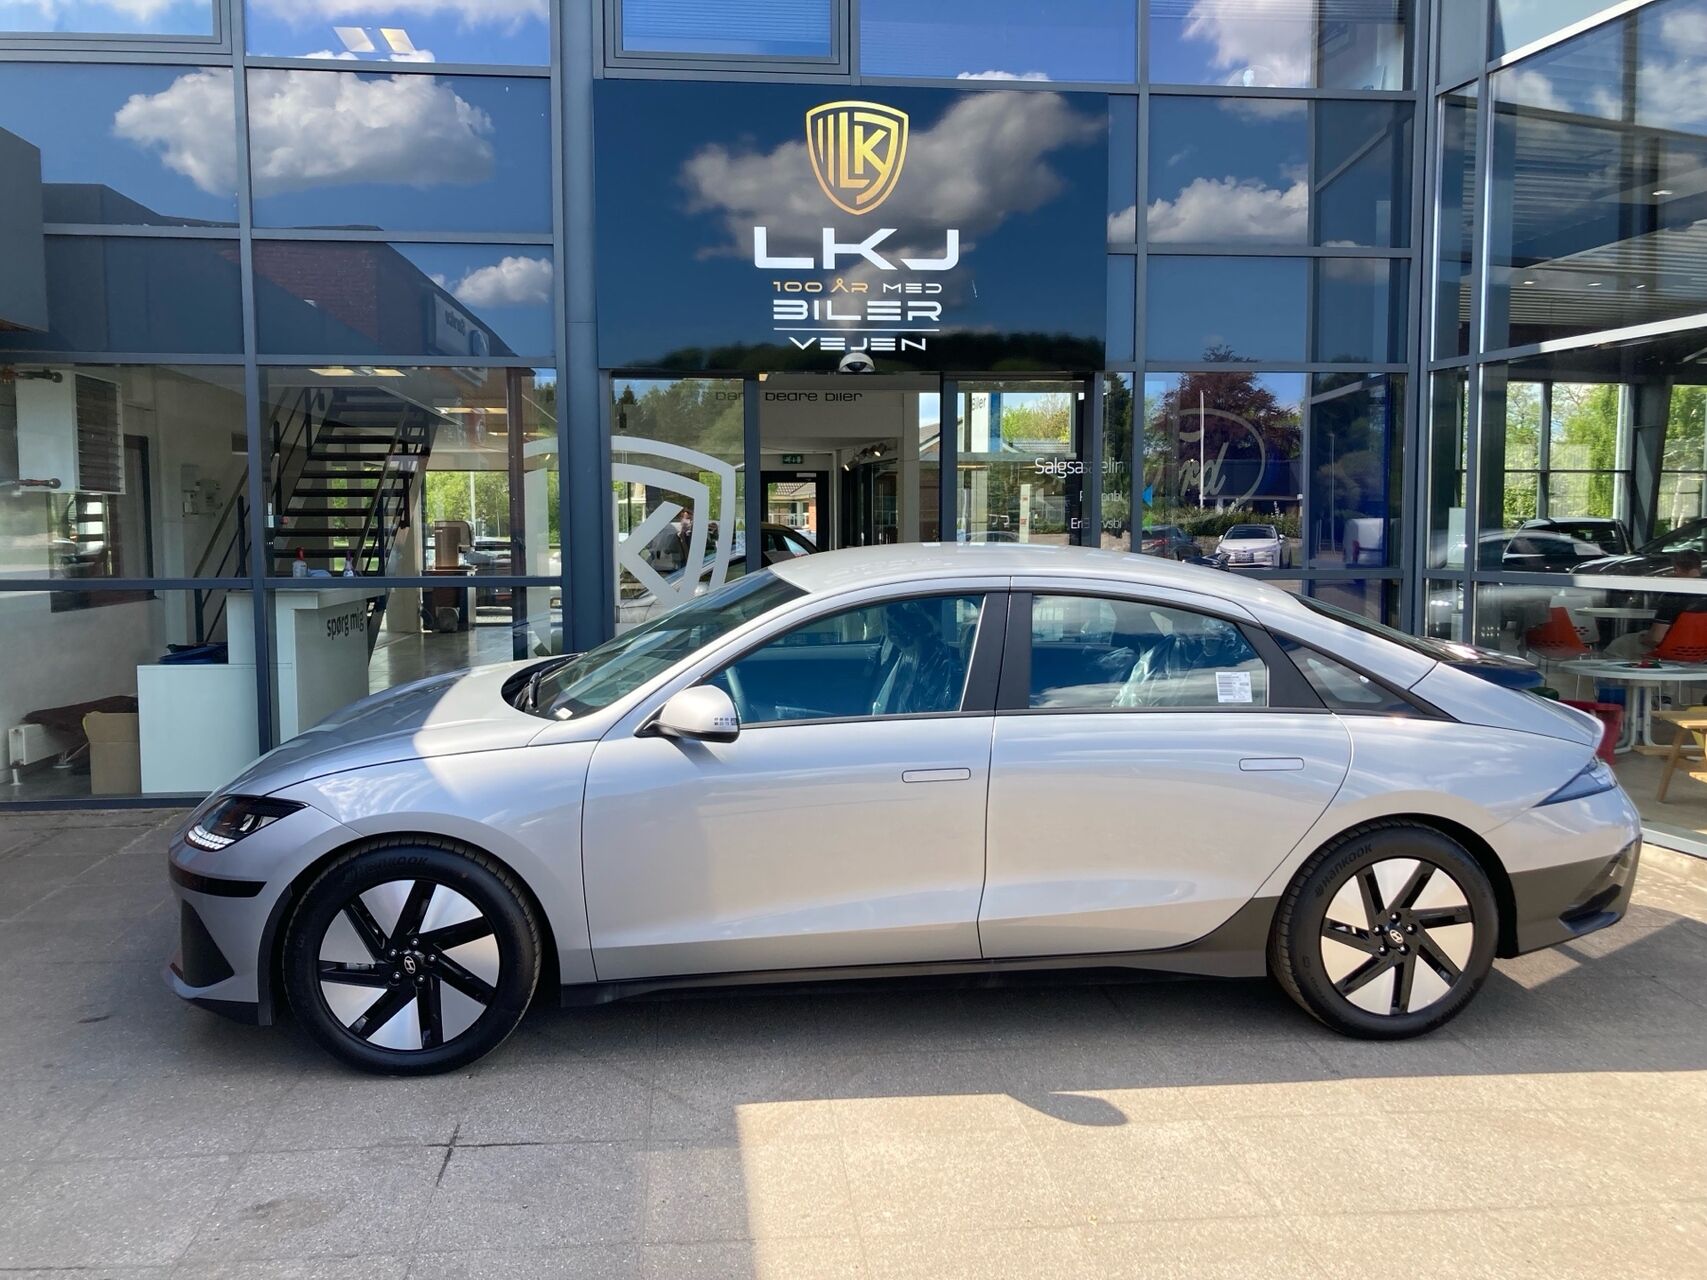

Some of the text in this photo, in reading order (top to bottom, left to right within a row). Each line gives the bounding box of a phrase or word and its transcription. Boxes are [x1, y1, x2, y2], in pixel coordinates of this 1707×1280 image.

[754, 226, 959, 271] LKJ
[773, 277, 942, 294] 100 ÅR MED
[773, 299, 942, 321] BILER
[789, 337, 926, 351] VEJEN
[327, 607, 364, 640] spørg mig
